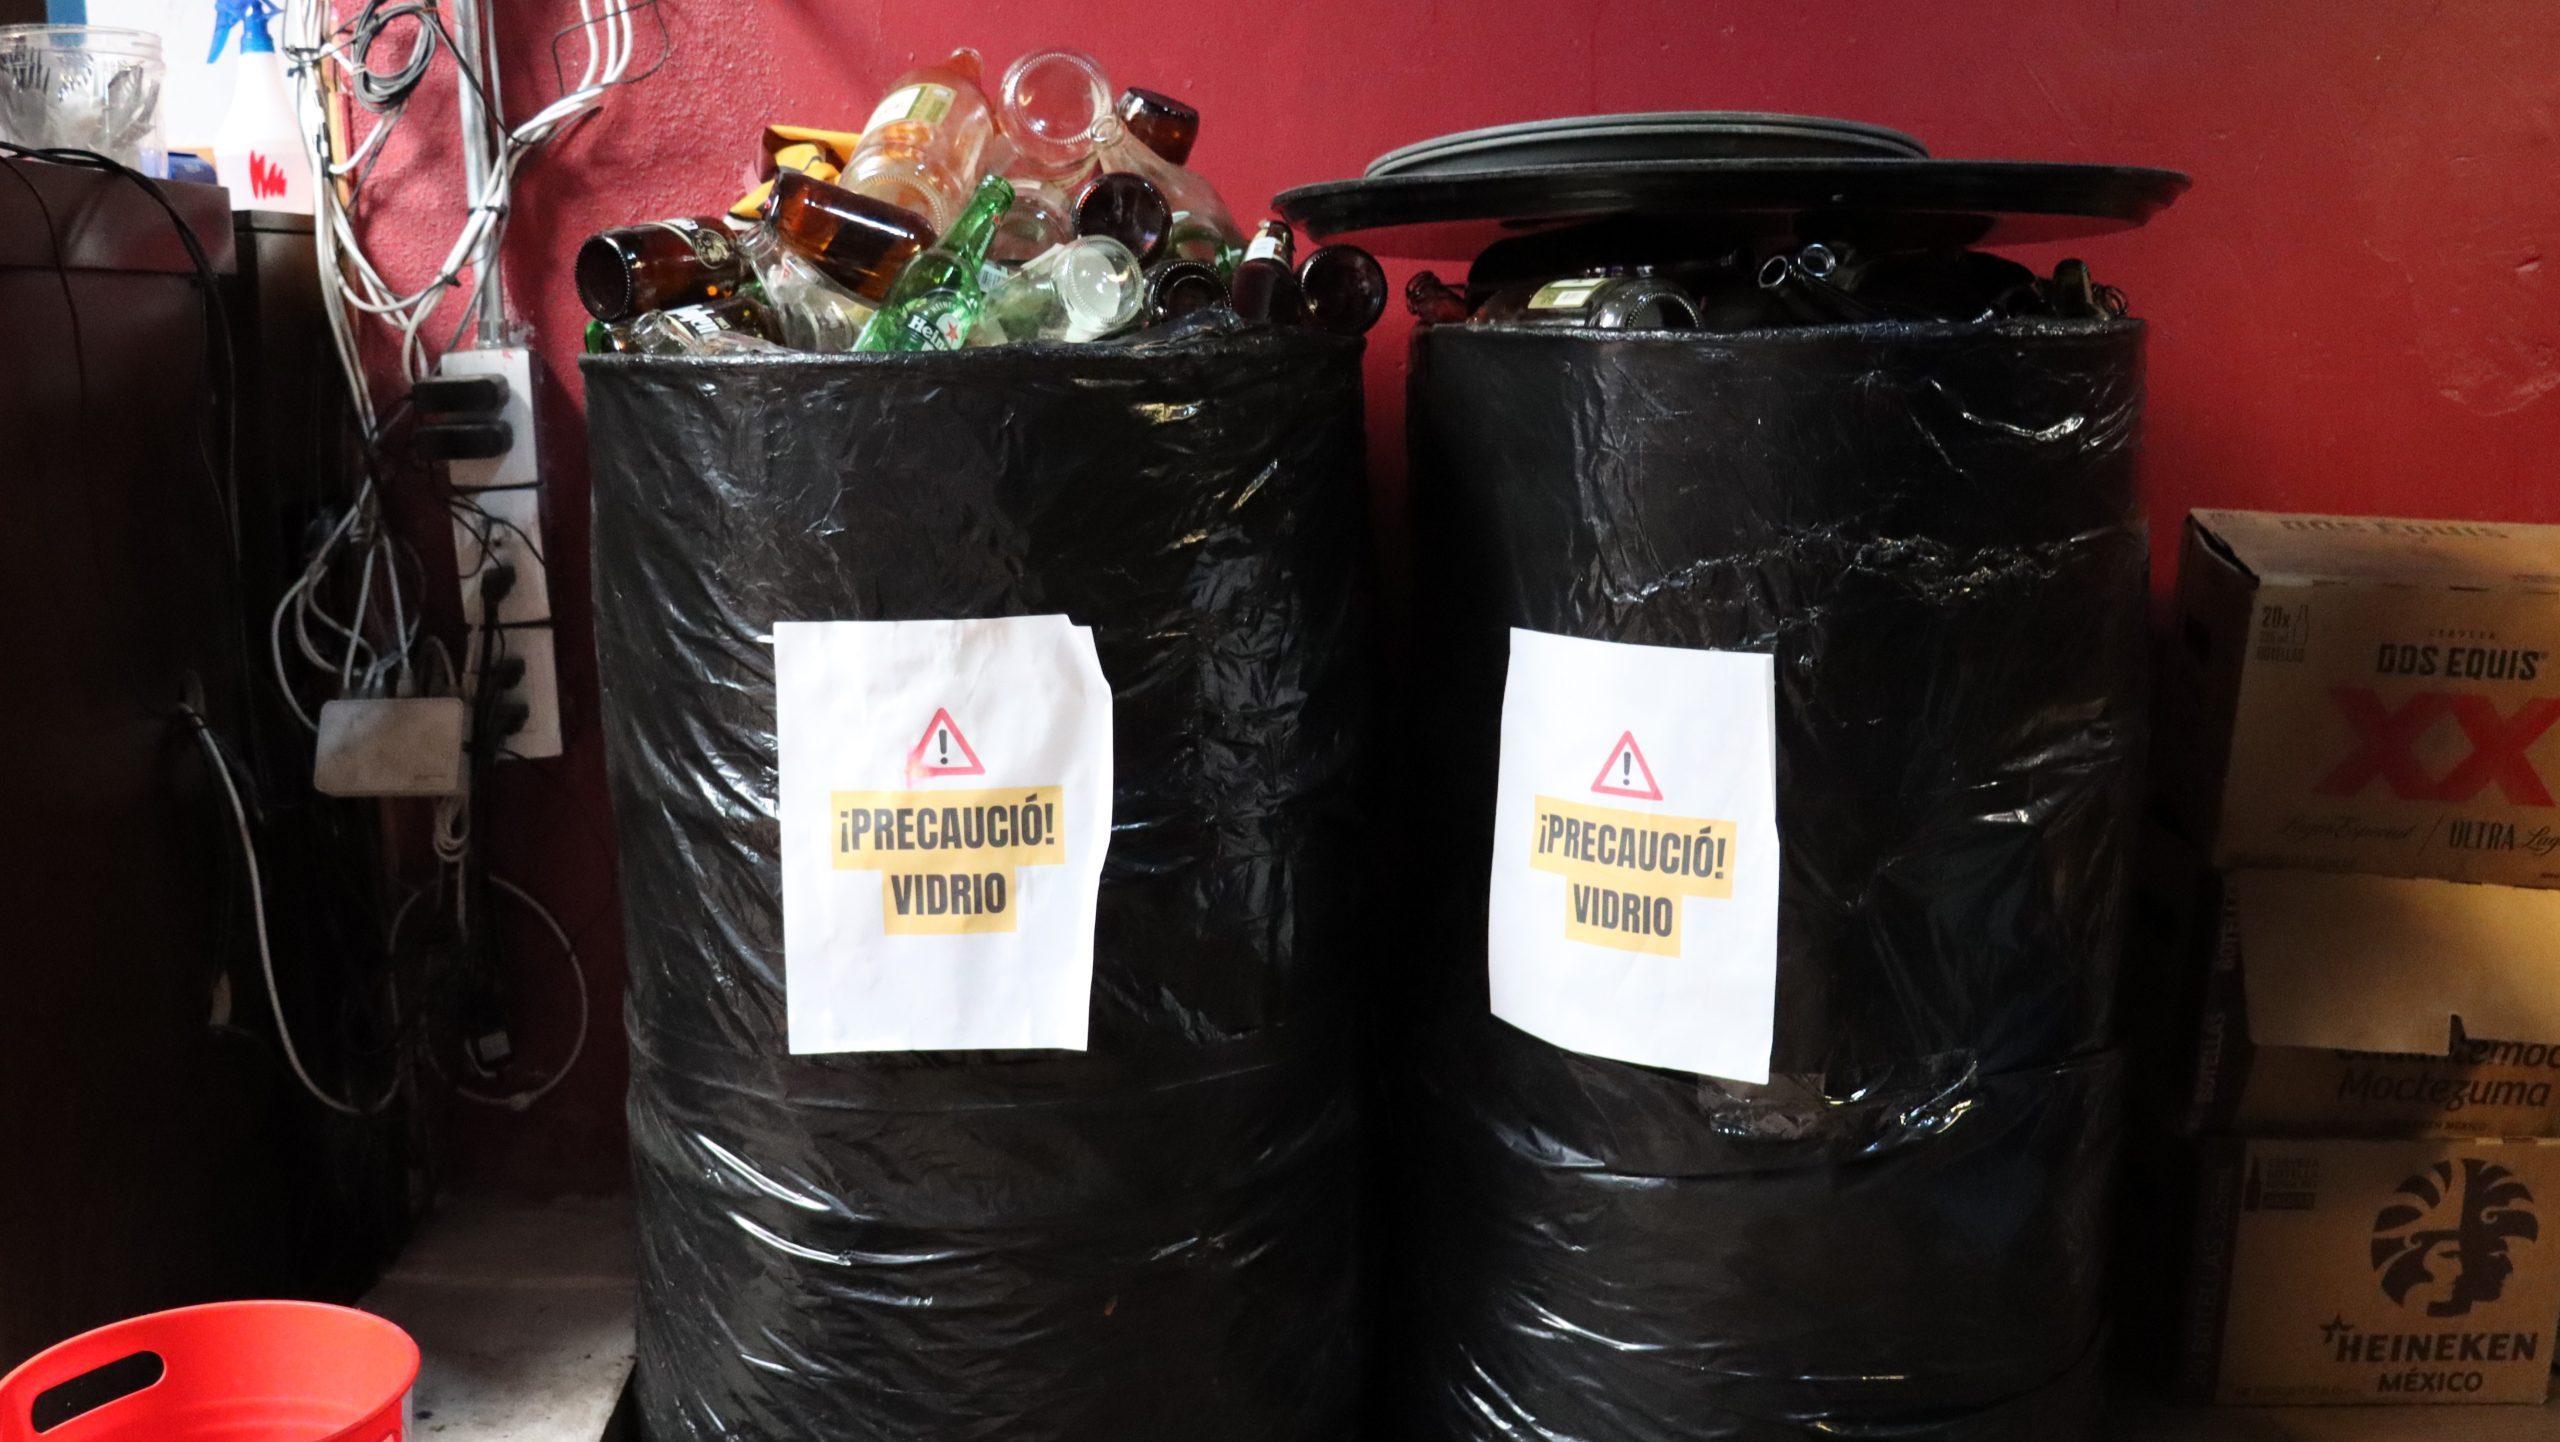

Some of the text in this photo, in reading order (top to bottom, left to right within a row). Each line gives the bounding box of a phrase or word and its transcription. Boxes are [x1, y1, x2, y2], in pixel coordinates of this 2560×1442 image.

[907, 314, 949, 351] Hein
[2376, 643, 2541, 681] DOS EQUIS
[2311, 685, 2560, 807] XX
[840, 793, 1055, 853] ¡PRECAUCIÓ!
[2449, 820, 2515, 851] ULTRA
[2521, 826, 2560, 857] Lag
[1538, 814, 1726, 880] ¡PRECAUCIÓ!
[891, 872, 1006, 915] VIDRIO
[1573, 883, 1673, 937] VIDRIO
[2337, 1069, 2551, 1111] Moctezuma
[2336, 1331, 2539, 1363] HEINEKEN
[2377, 1366, 2484, 1392] MÉXICO
